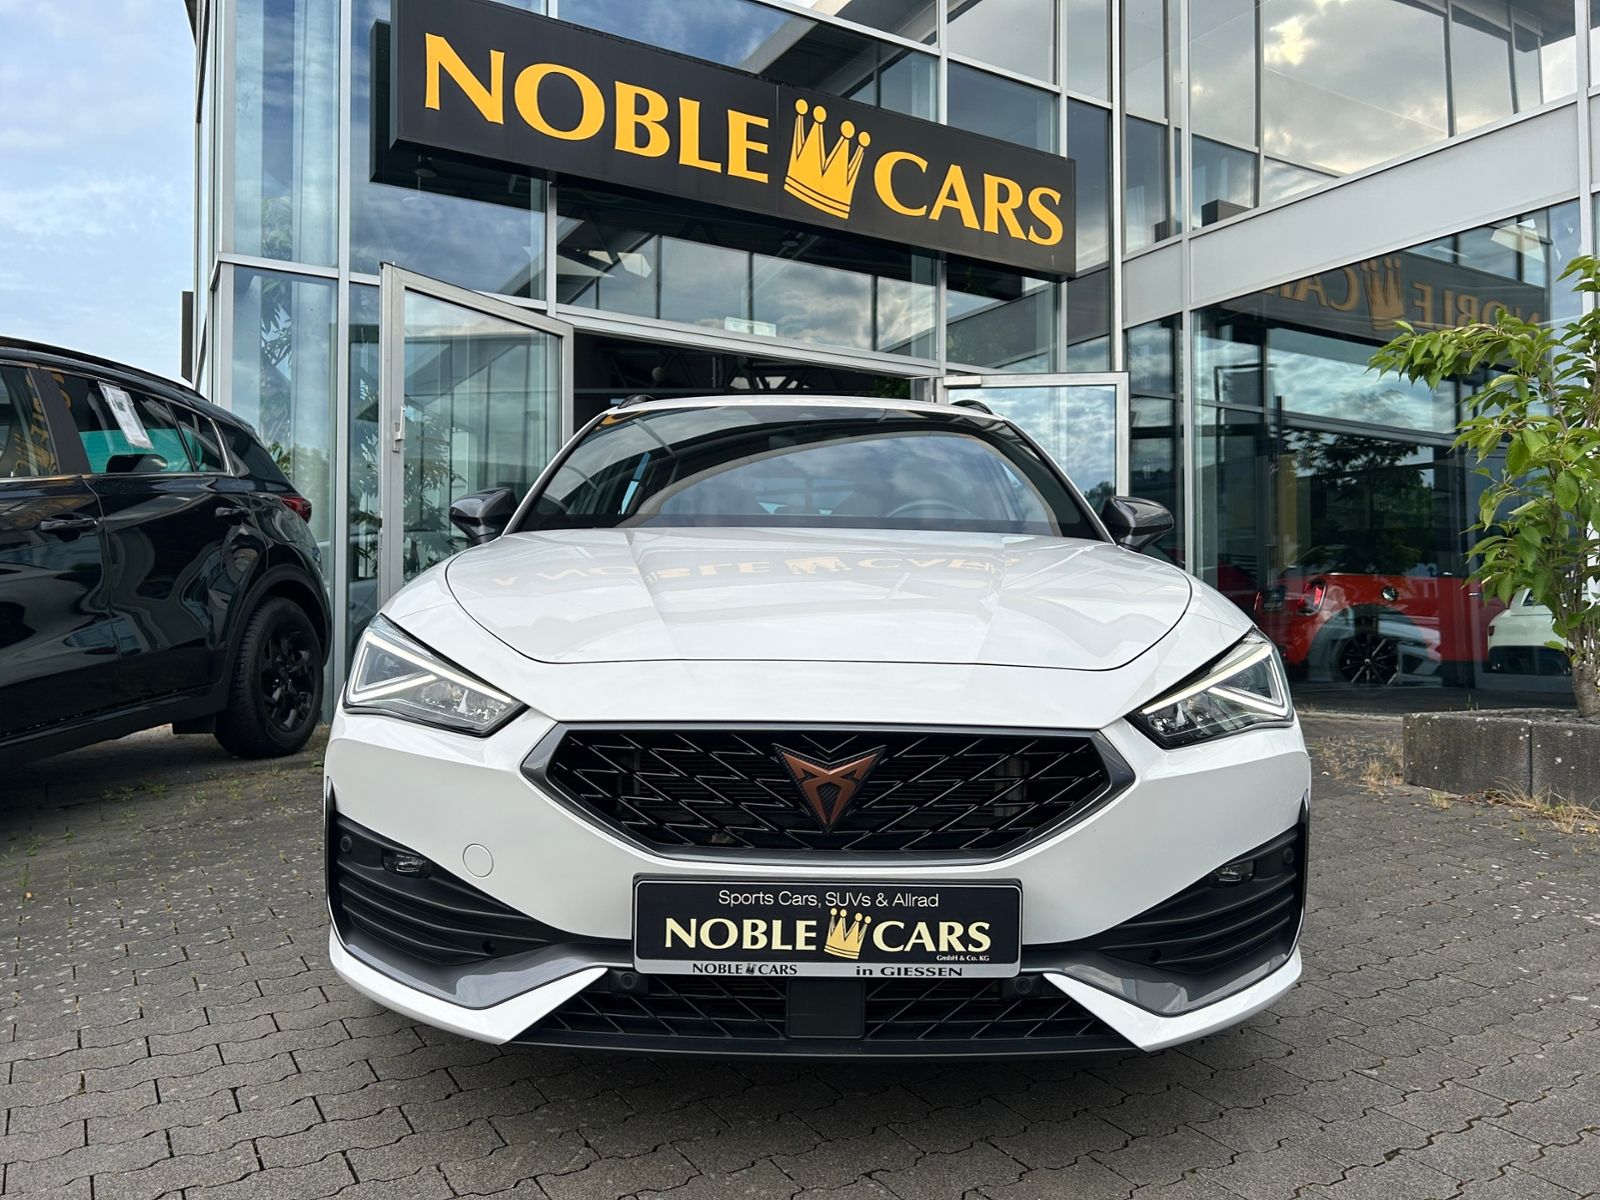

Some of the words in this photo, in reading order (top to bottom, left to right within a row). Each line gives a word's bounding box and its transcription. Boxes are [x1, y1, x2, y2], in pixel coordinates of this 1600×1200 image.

[426, 34, 769, 183] NOBLE
[874, 152, 1063, 245] CARS
[718, 889, 775, 908] Sports
[779, 890, 822, 909] Cars,
[825, 891, 871, 907] SUVs
[876, 892, 889, 907] &
[892, 892, 939, 908] Allrad
[665, 917, 817, 951] NOBLE
[872, 920, 991, 953] CARS
[692, 963, 743, 975] NOBLE
[758, 964, 798, 975] CARS
[856, 965, 873, 976] in
[880, 966, 963, 977] GIESSEN
